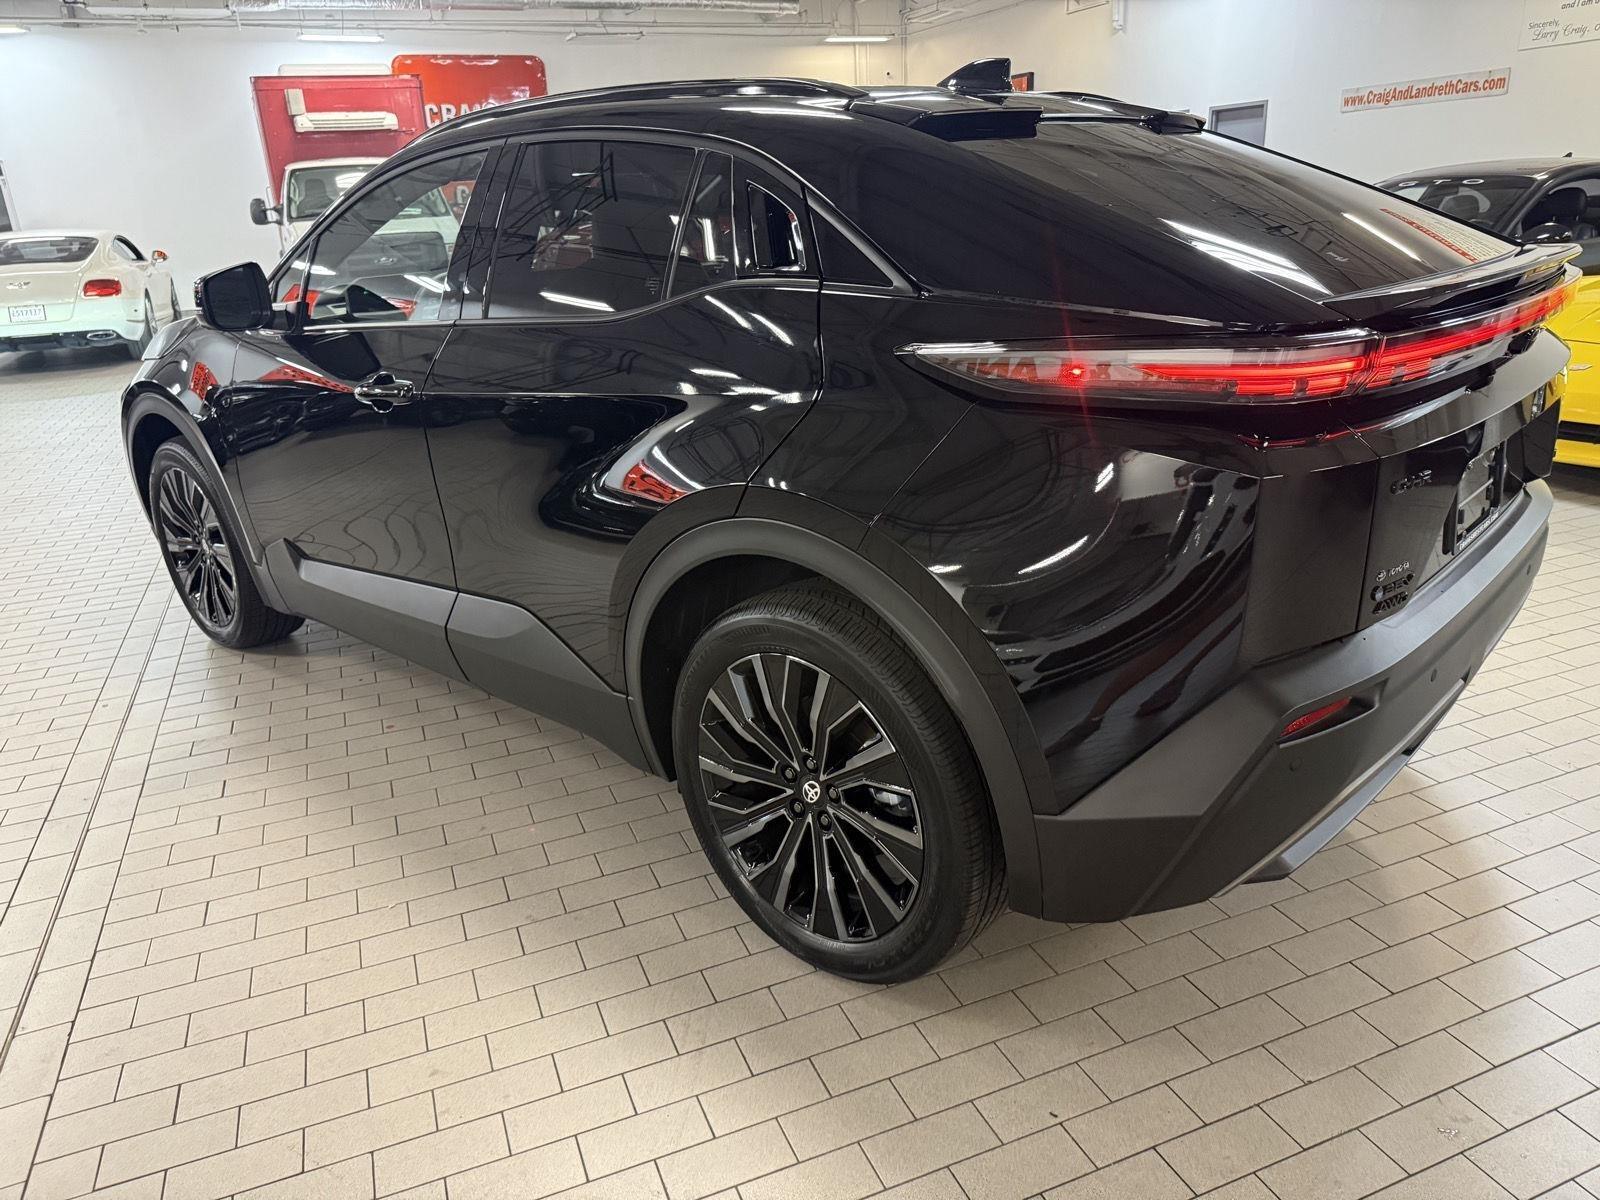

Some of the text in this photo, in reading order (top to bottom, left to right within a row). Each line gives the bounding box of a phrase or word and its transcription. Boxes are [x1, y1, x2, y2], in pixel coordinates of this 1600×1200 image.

[1561, 0, 1577, 9] and
[1528, 19, 1560, 30] Sincerely,
[1532, 28, 1560, 41] Larry
[1343, 76, 1506, 107] www.CraigAndLandrethCars.com
